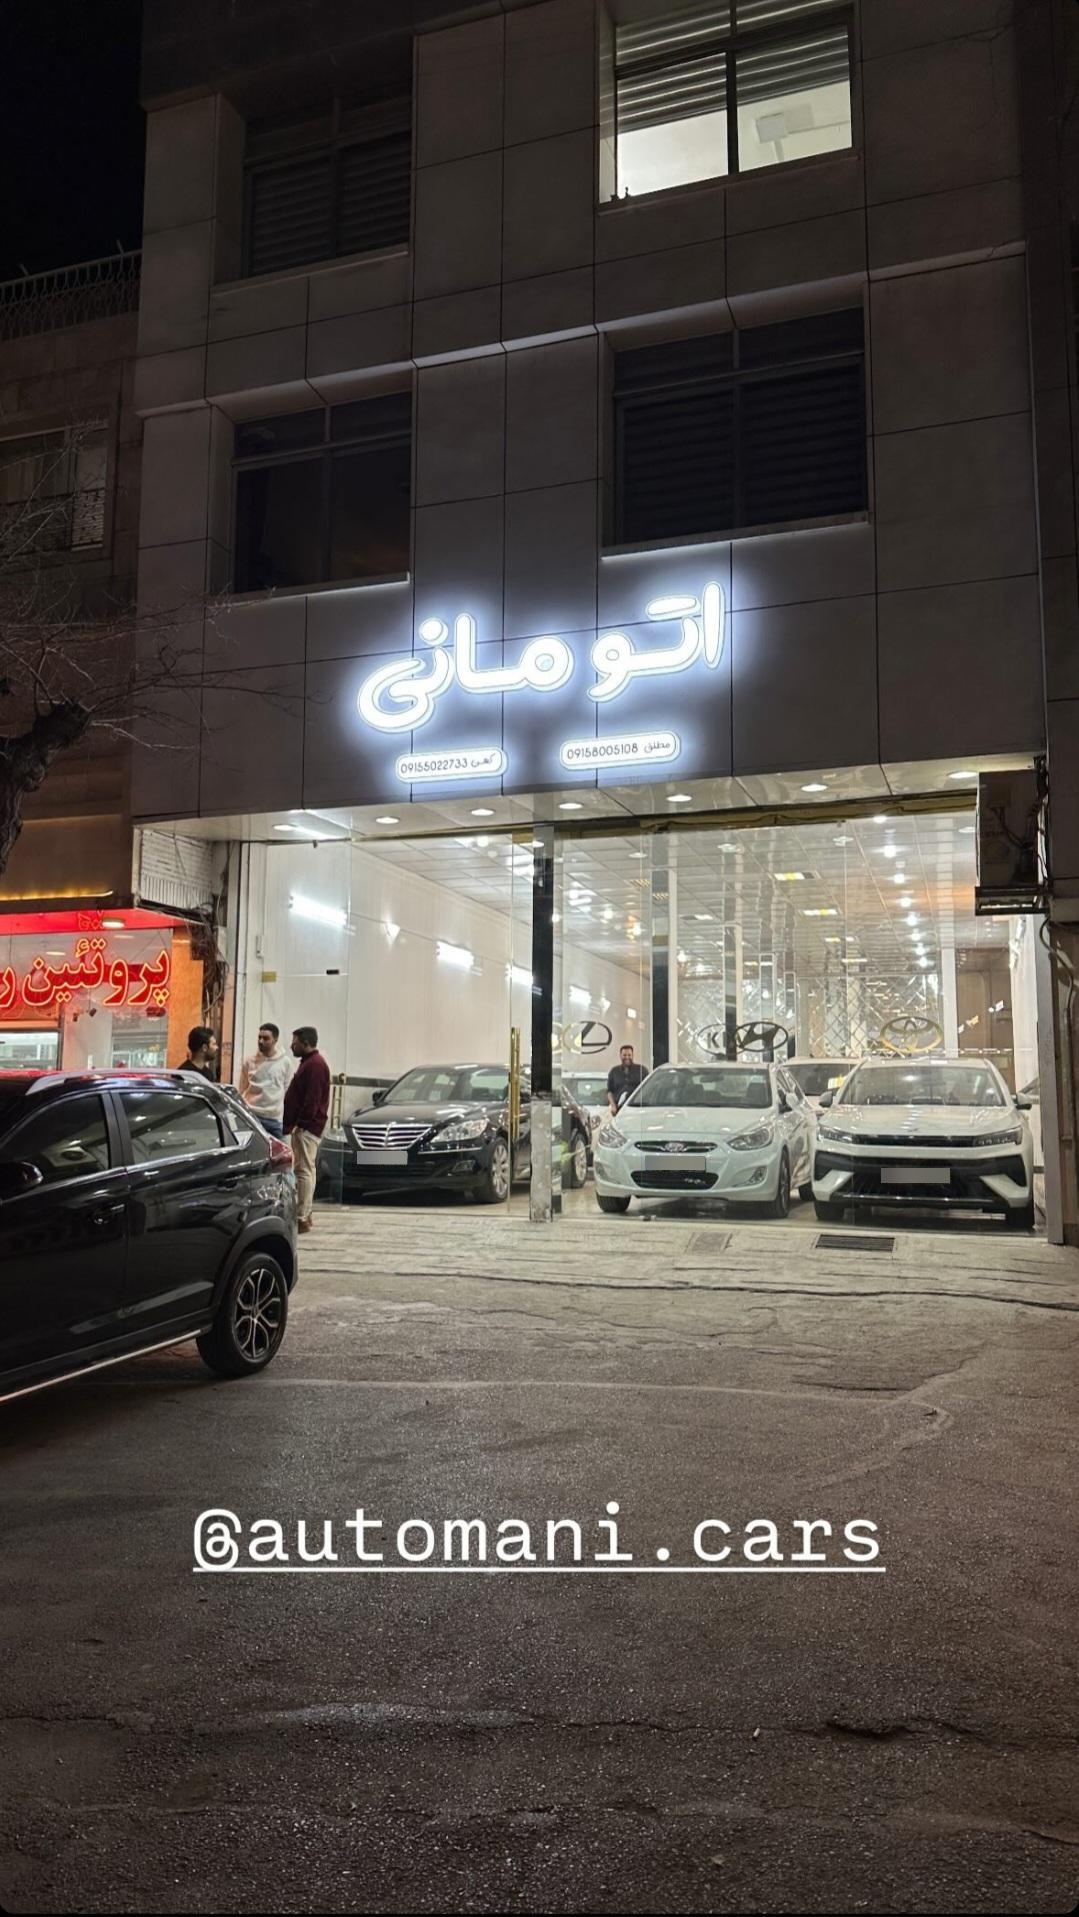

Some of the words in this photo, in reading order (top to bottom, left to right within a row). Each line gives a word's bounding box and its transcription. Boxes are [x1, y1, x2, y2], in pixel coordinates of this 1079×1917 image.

[358, 613, 574, 732] مانی
[567, 742, 639, 760] 09158005108
[400, 757, 468, 774] 09155022733
